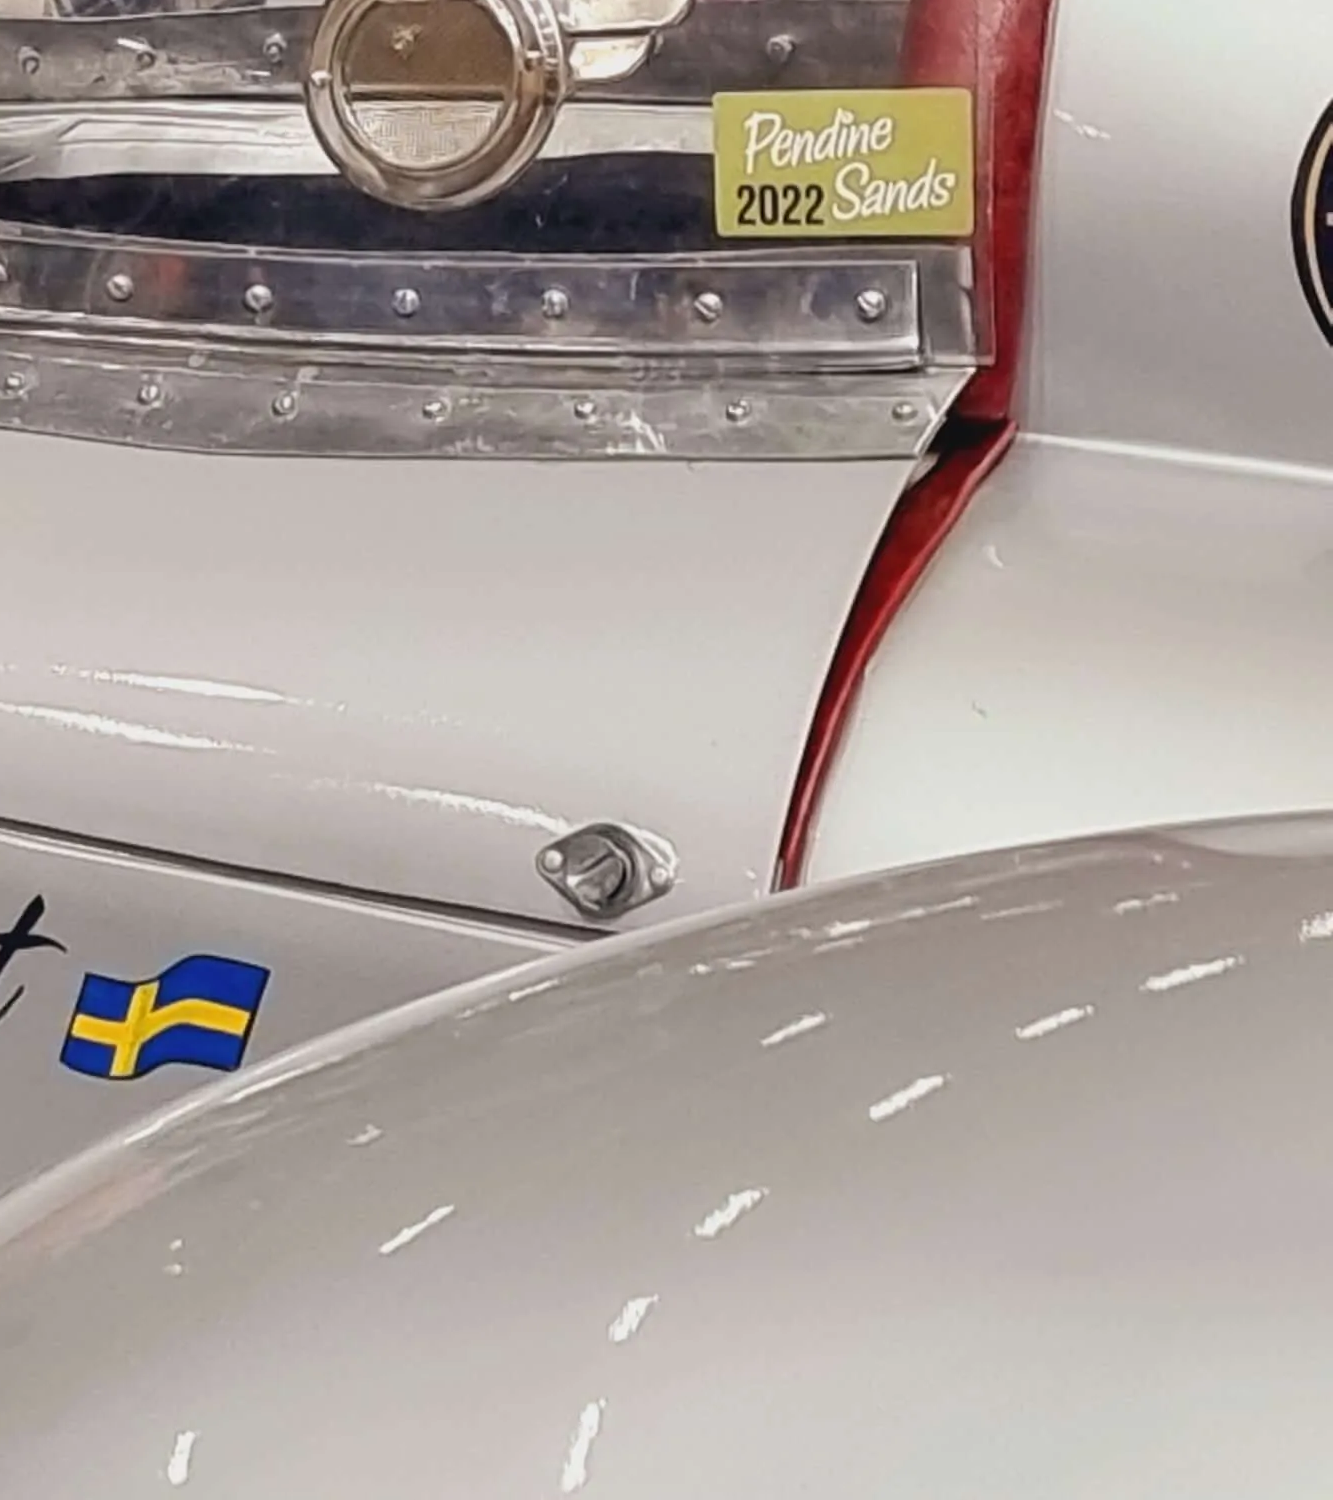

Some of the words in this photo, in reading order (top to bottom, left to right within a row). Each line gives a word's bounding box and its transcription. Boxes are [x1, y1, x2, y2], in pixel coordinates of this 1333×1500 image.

[743, 107, 893, 175] Pendine
[737, 184, 825, 226] 2022
[832, 158, 956, 221] Sands
